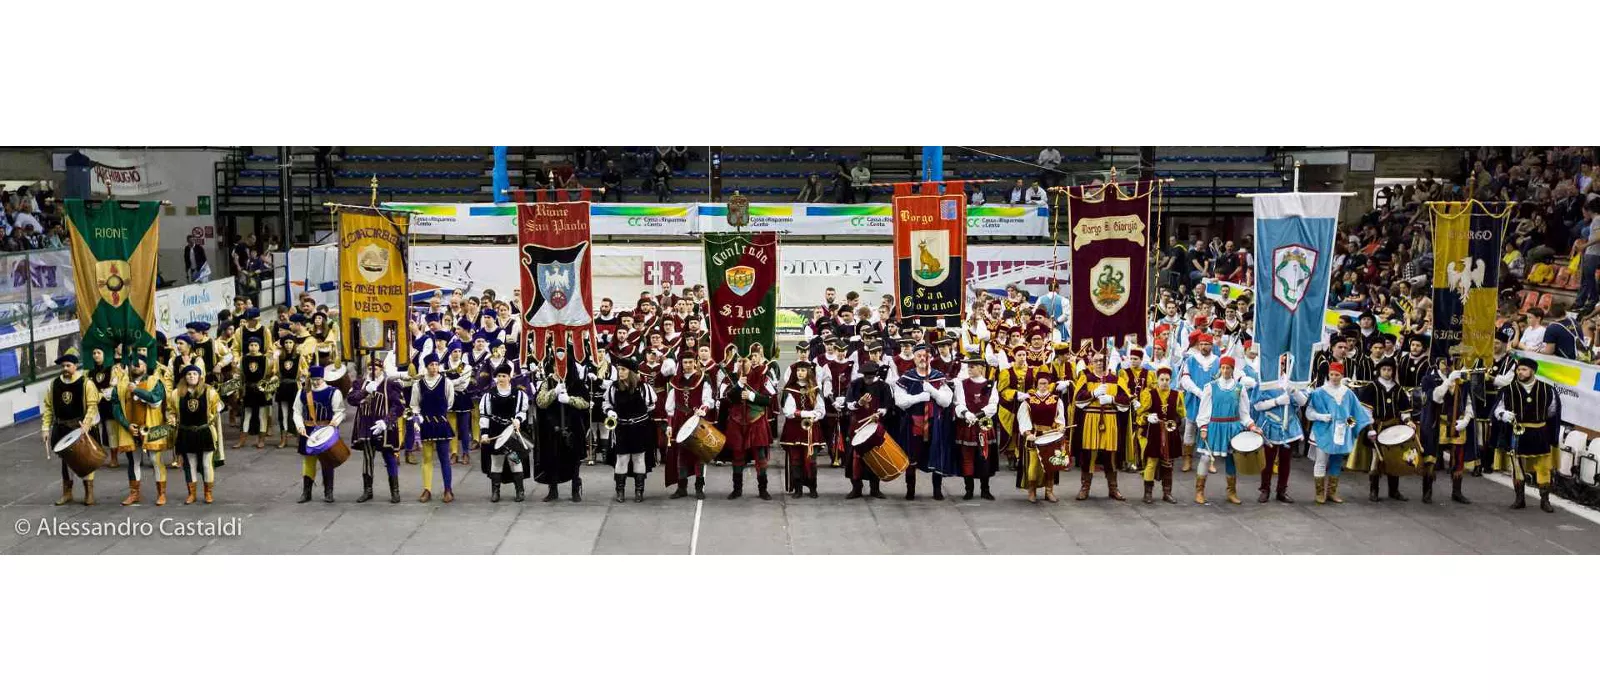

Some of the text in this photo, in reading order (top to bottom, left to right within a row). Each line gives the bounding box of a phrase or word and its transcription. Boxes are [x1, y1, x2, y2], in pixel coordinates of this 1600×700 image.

[535, 204, 569, 217] Rione
[901, 209, 934, 225] Borgo
[95, 227, 128, 240] RIONE
[523, 219, 549, 234] San
[552, 219, 587, 235] Paolo
[711, 242, 768, 266] Contrada
[915, 287, 943, 300] San
[736, 304, 767, 319] Luca
[903, 296, 958, 312] Giovanni
